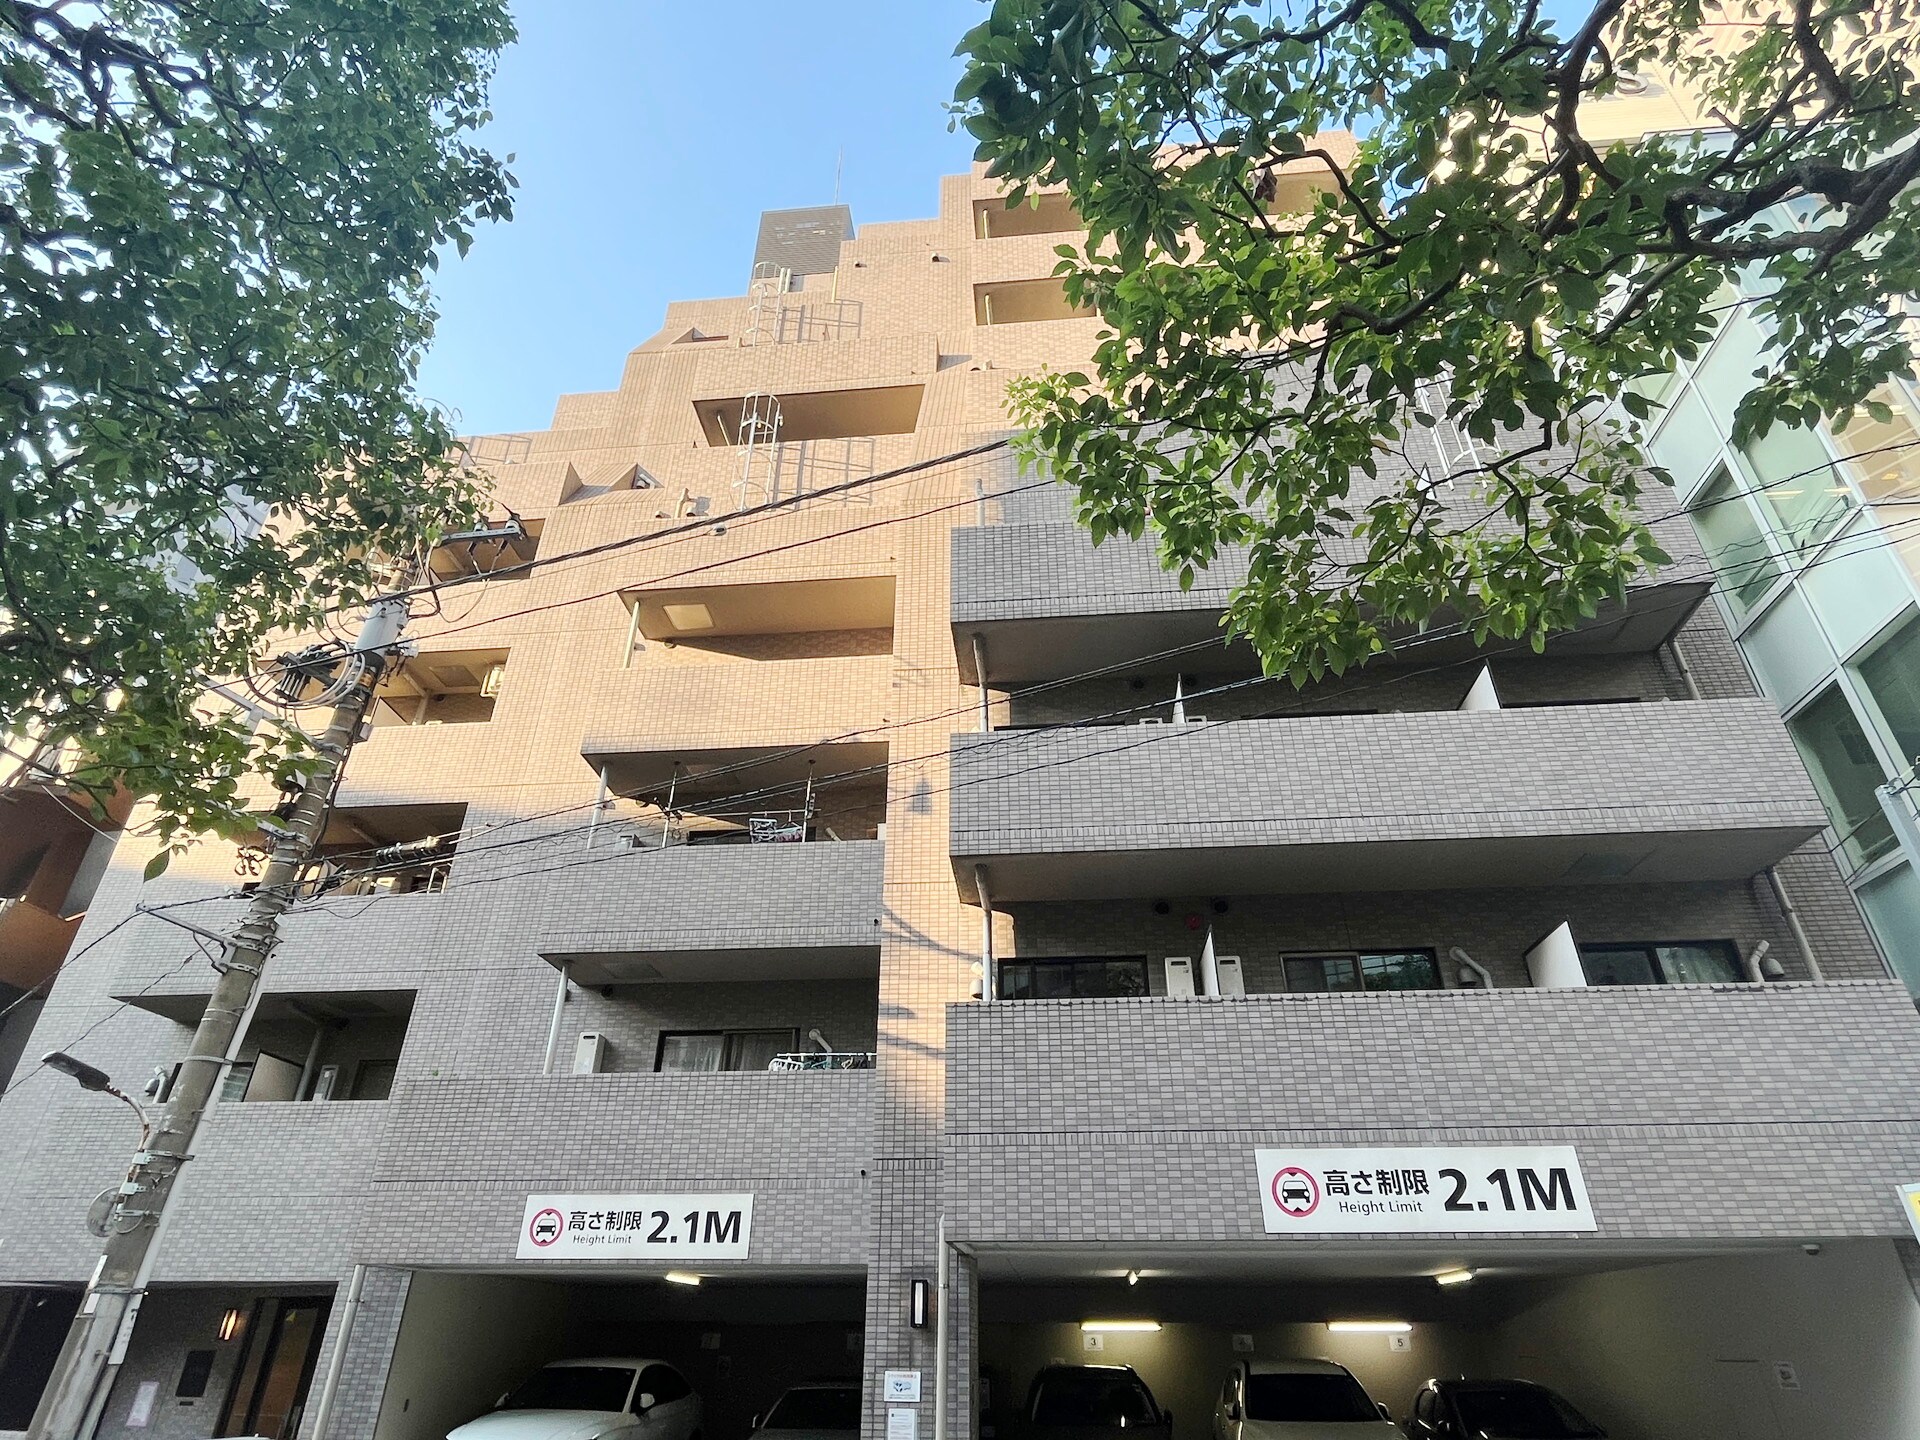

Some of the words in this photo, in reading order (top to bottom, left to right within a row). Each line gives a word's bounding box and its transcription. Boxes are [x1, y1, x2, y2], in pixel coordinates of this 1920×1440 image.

[1322, 1168, 1430, 1196] 高さ制限
[1438, 1167, 1578, 1212] 2.1M
[1339, 1201, 1385, 1216] Height
[1389, 1201, 1423, 1213] Limit
[568, 1210, 643, 1231] 高さ制限
[646, 1210, 742, 1244] 2.1M
[572, 1234, 605, 1247] Height
[607, 1234, 632, 1245] Limit
[1090, 1337, 1097, 1346] 3
[1397, 1338, 1404, 1347] 5
